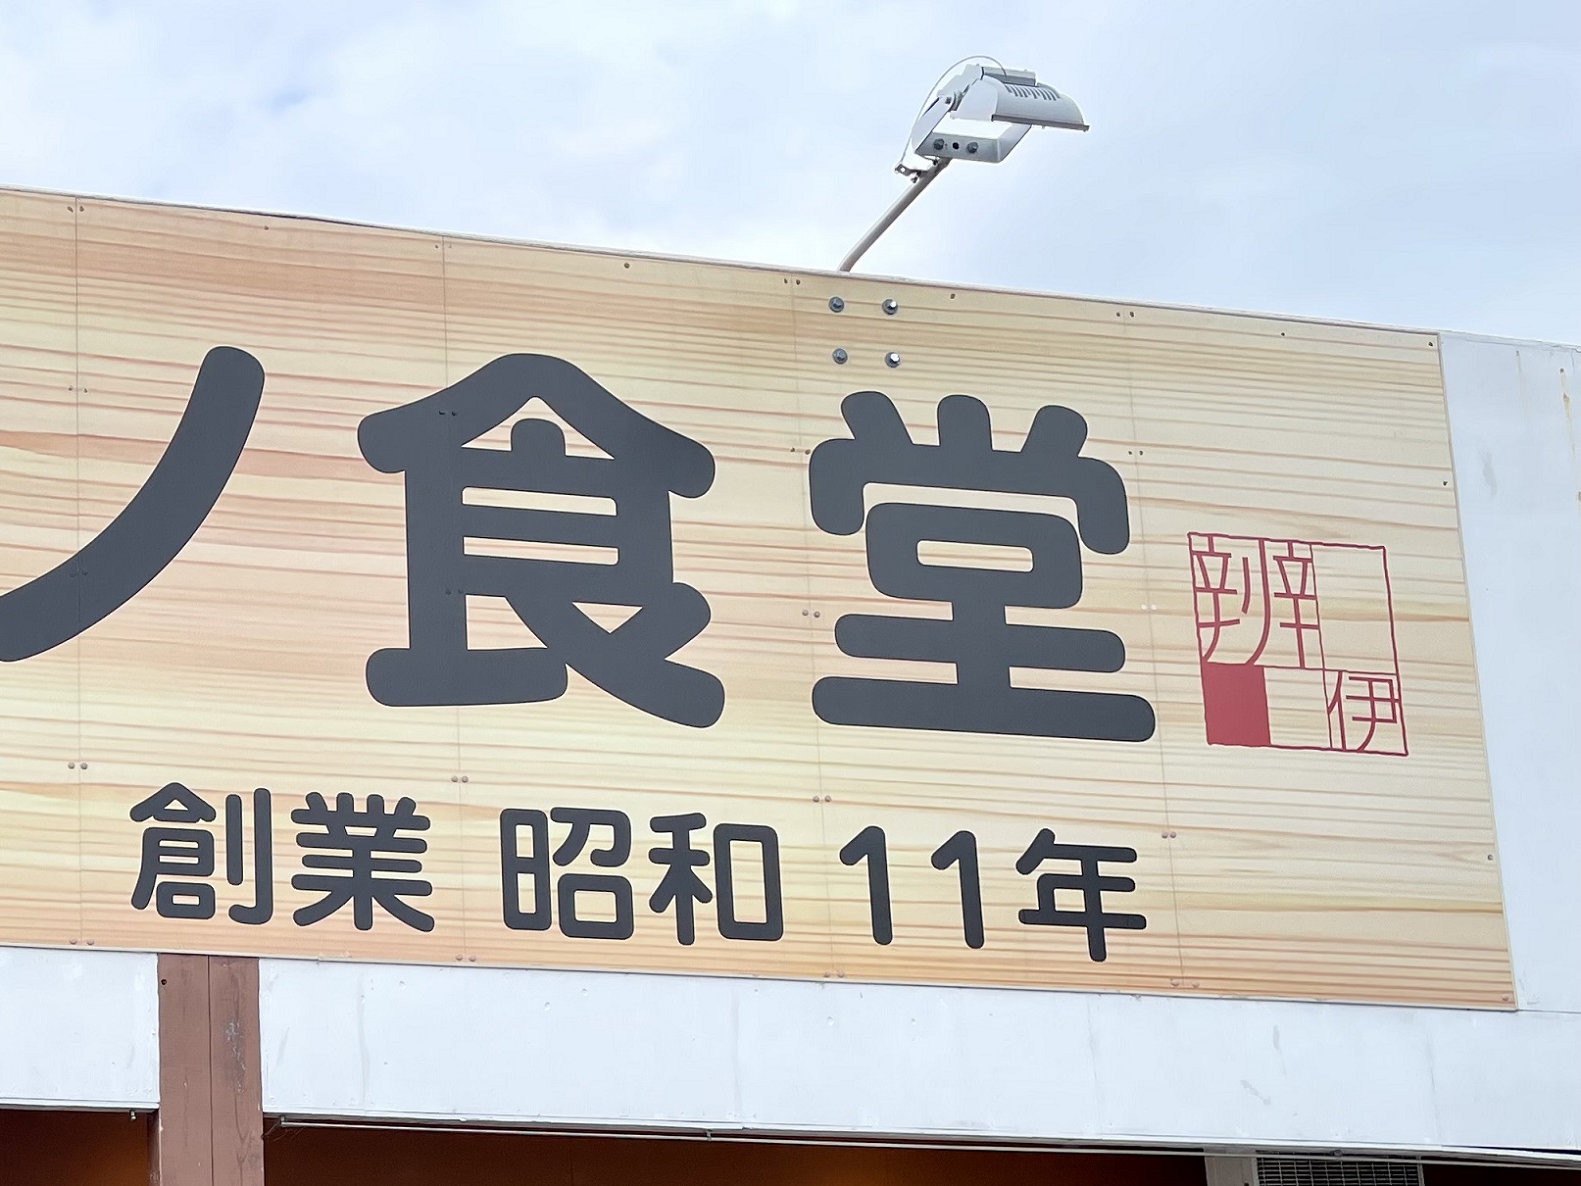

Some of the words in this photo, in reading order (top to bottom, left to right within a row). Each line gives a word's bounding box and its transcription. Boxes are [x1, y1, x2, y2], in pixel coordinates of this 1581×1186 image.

[130, 783, 434, 932] 創業
[500, 808, 783, 945] 昭和
[840, 826, 1146, 962] 11年
